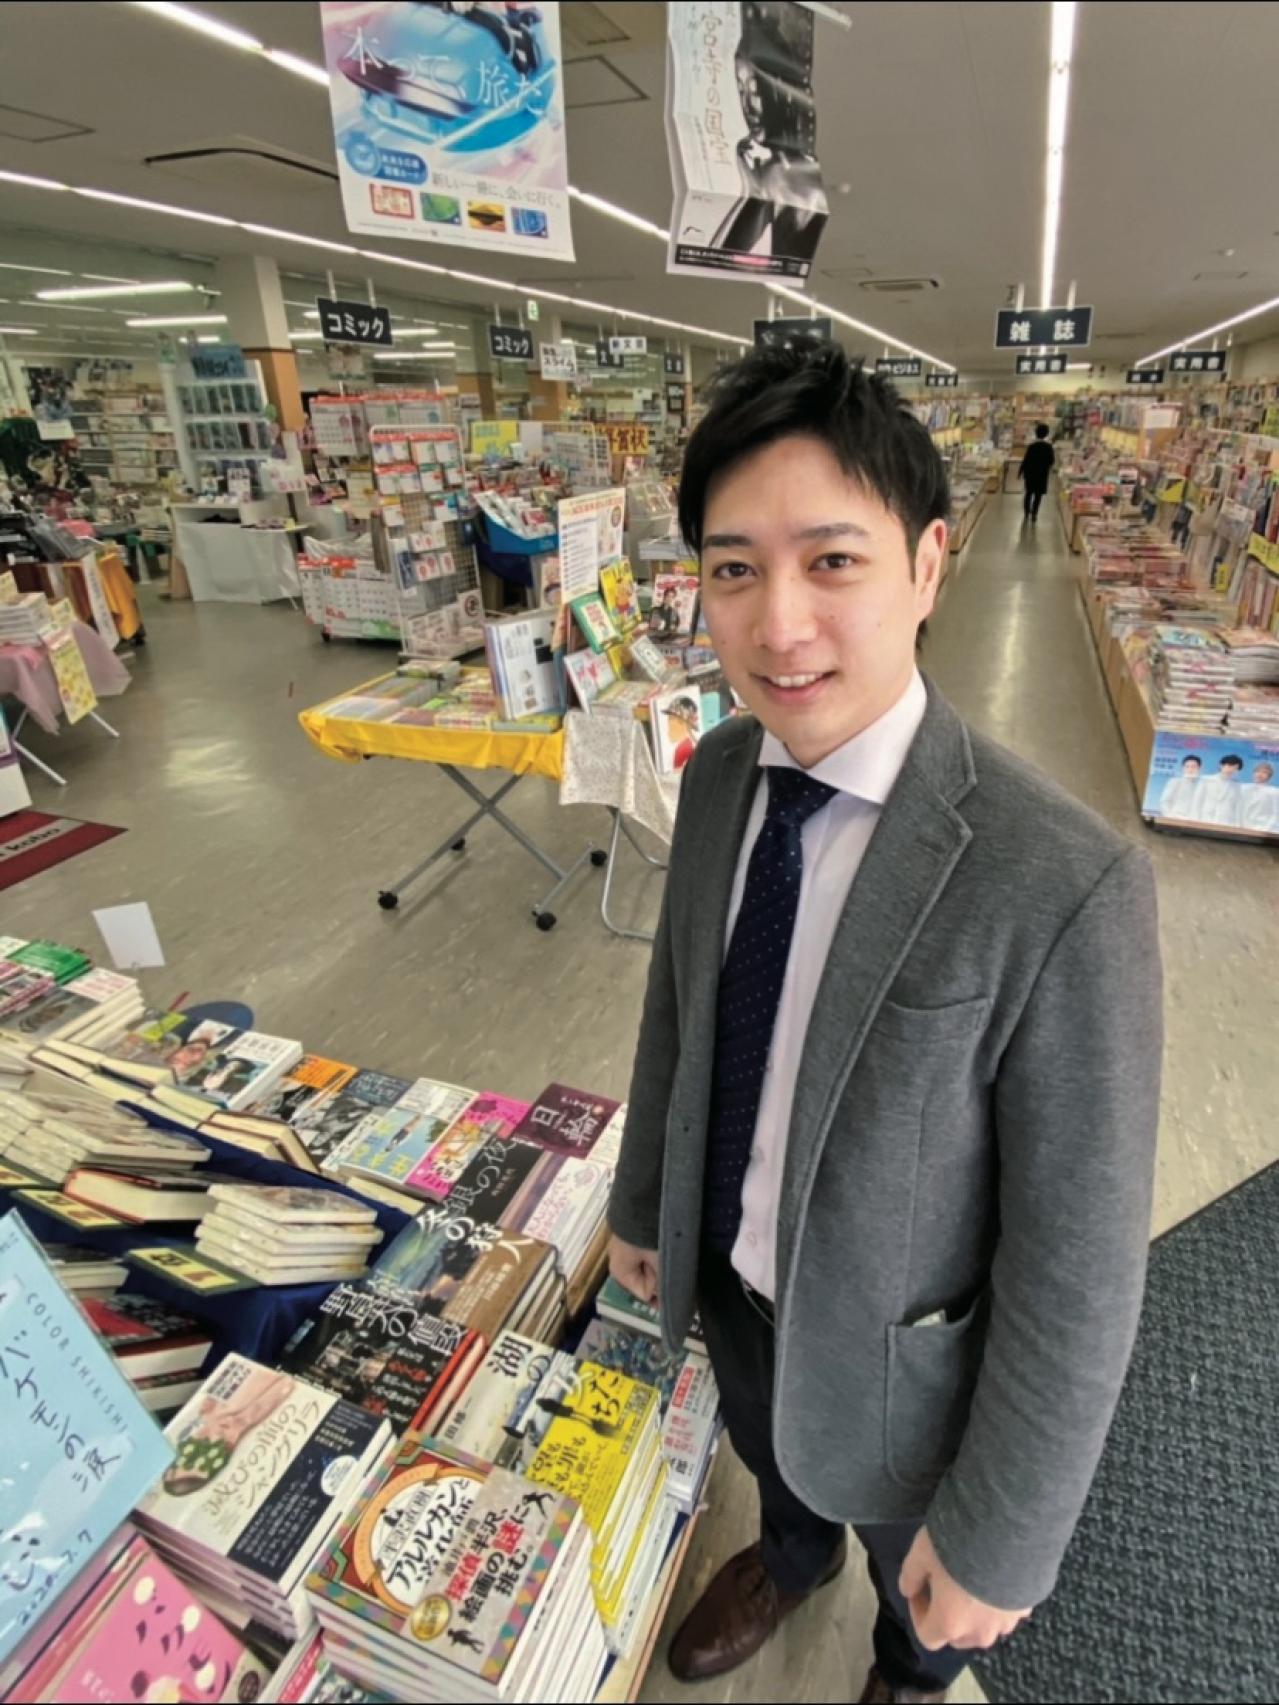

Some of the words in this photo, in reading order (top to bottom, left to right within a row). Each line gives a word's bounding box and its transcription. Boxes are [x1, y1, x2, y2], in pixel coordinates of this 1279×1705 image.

[326, 312, 385, 341] コミック
[1009, 319, 1076, 343] 雑誌
[493, 333, 531, 356] コミック
[25, 1291, 71, 1353] COLOR
[70, 1355, 129, 1435] SHIKISHI
[384, 1478, 471, 1591] アルルカンと
